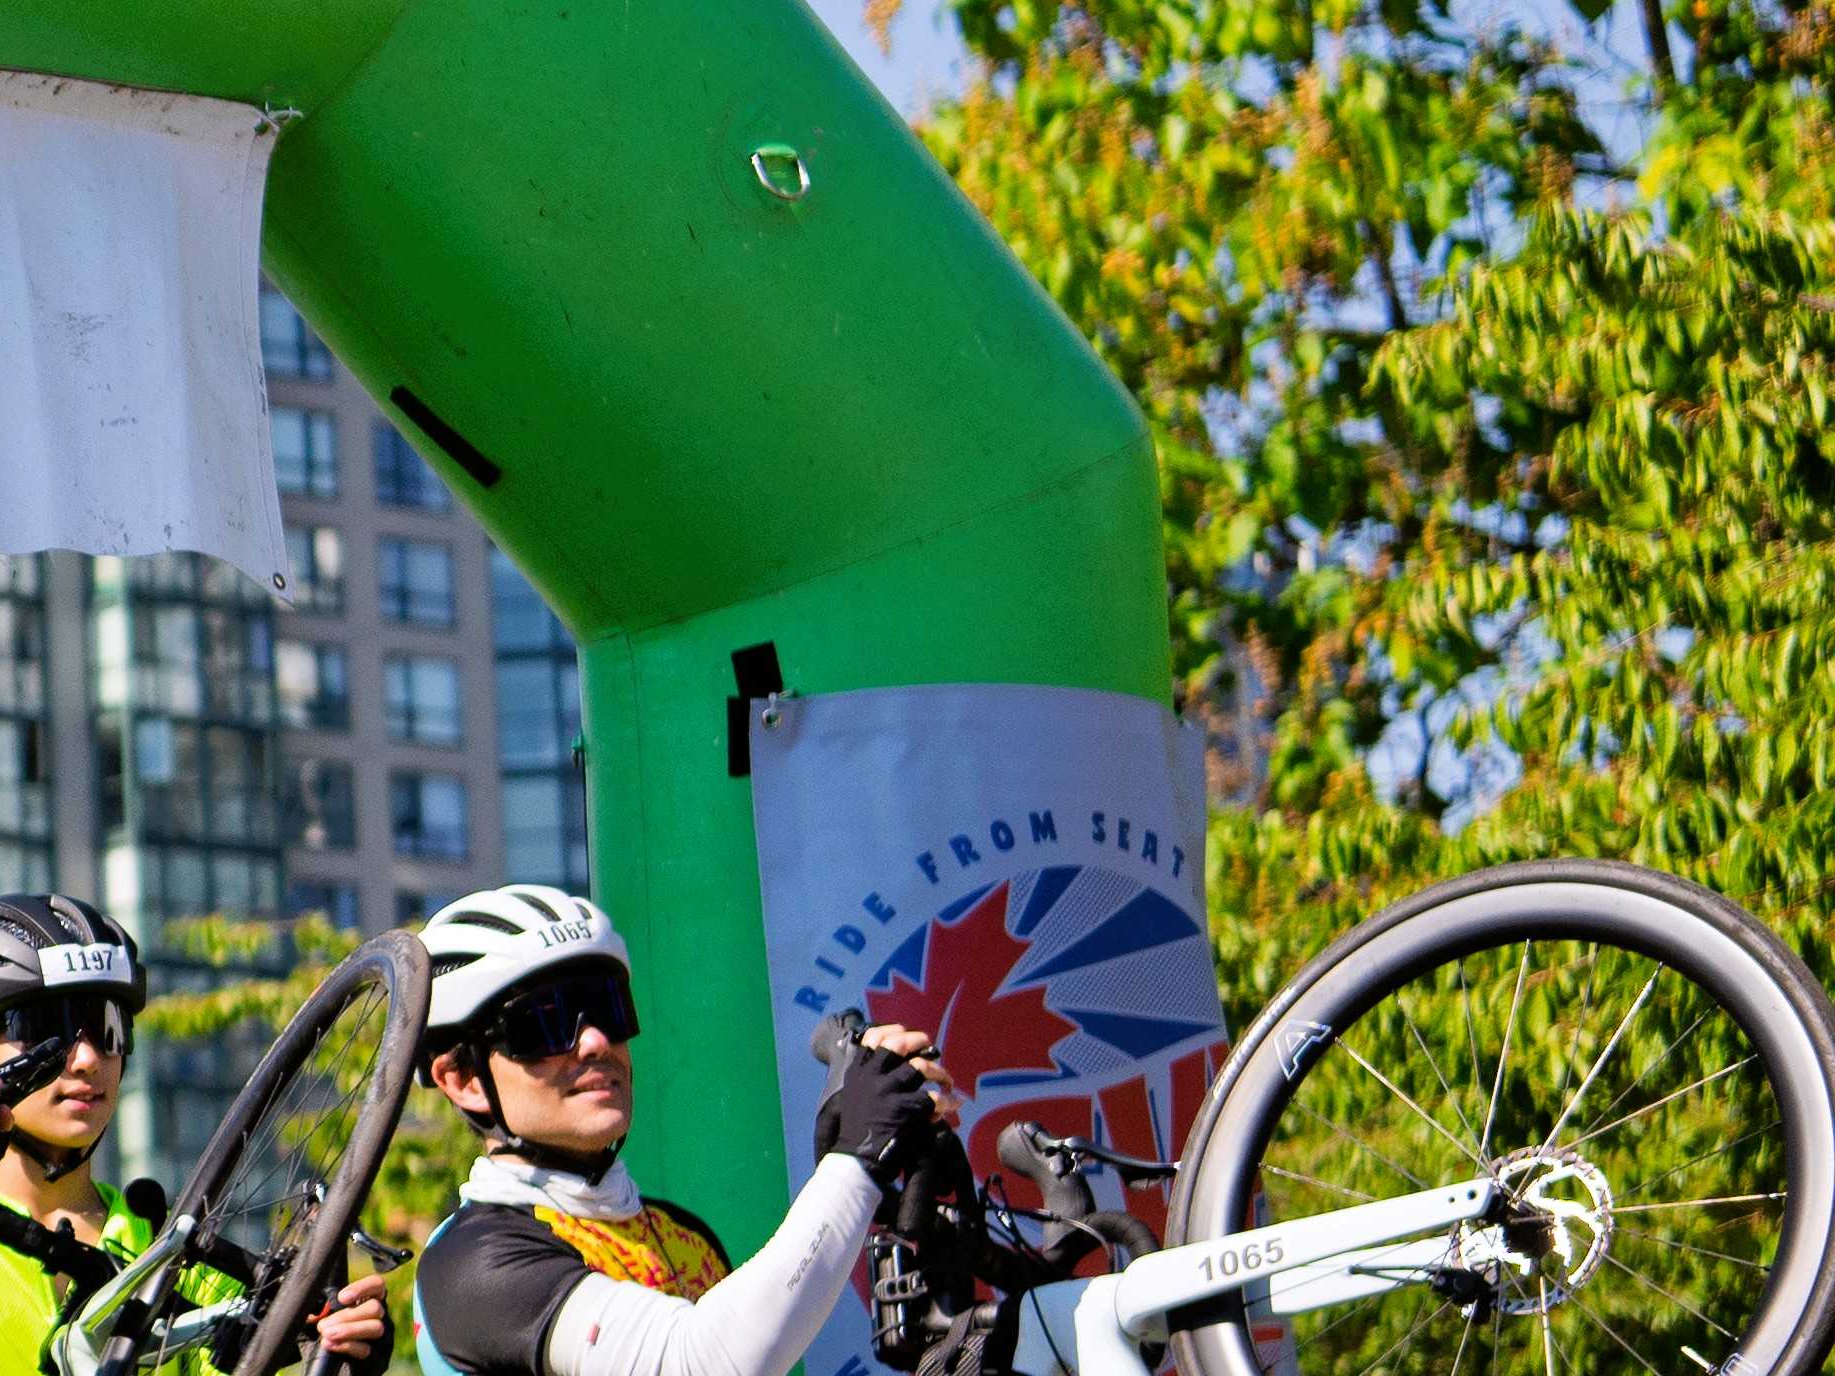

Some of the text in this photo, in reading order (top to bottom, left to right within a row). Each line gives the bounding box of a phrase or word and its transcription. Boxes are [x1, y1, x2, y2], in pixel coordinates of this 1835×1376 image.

[792, 890, 898, 1015] RIDE
[916, 810, 1059, 885] FROM
[536, 918, 593, 949] 1065
[61, 948, 116, 974] 1197
[1196, 1235, 1286, 1284] 1065
